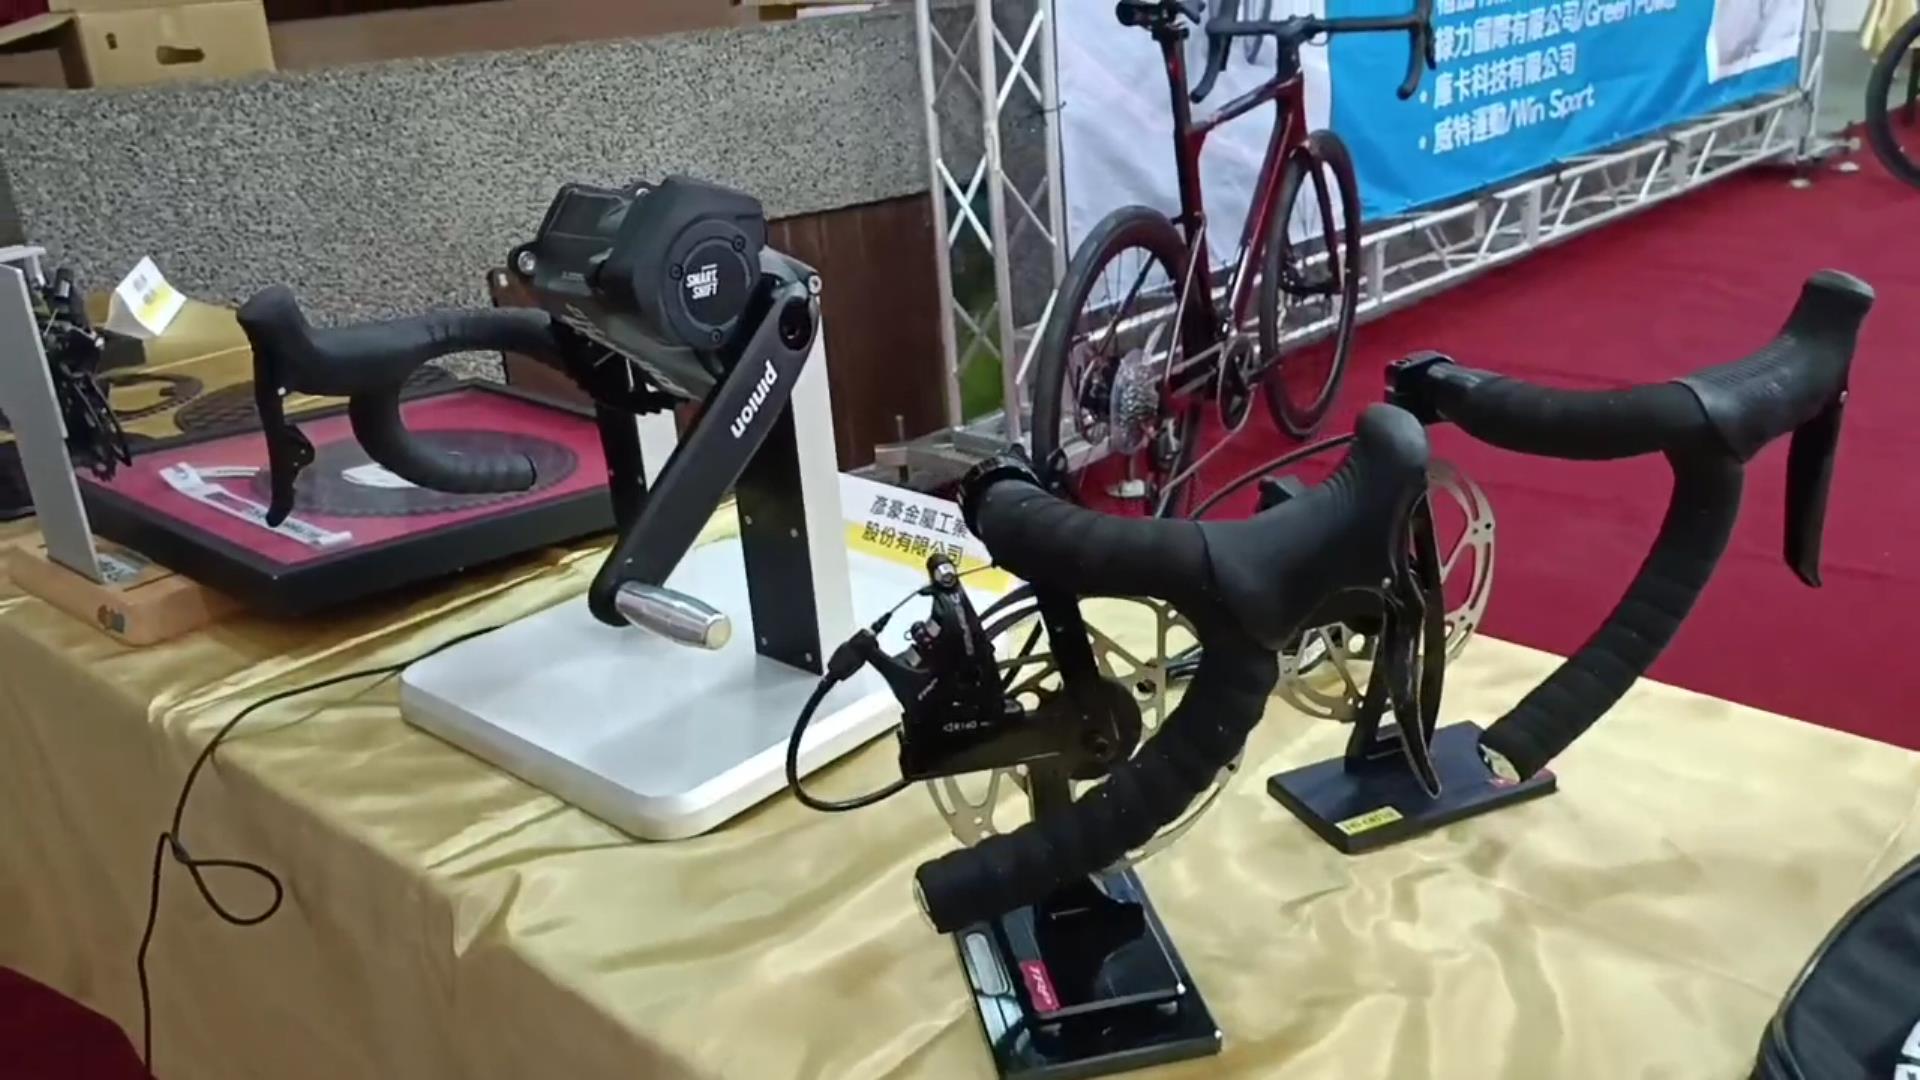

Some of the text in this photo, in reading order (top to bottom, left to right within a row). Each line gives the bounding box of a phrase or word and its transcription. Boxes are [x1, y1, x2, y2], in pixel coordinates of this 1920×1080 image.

[1549, 82, 1596, 120] Sport
[686, 267, 718, 288] SMART
[692, 282, 718, 299] SHIFT
[729, 358, 778, 440] pinion
